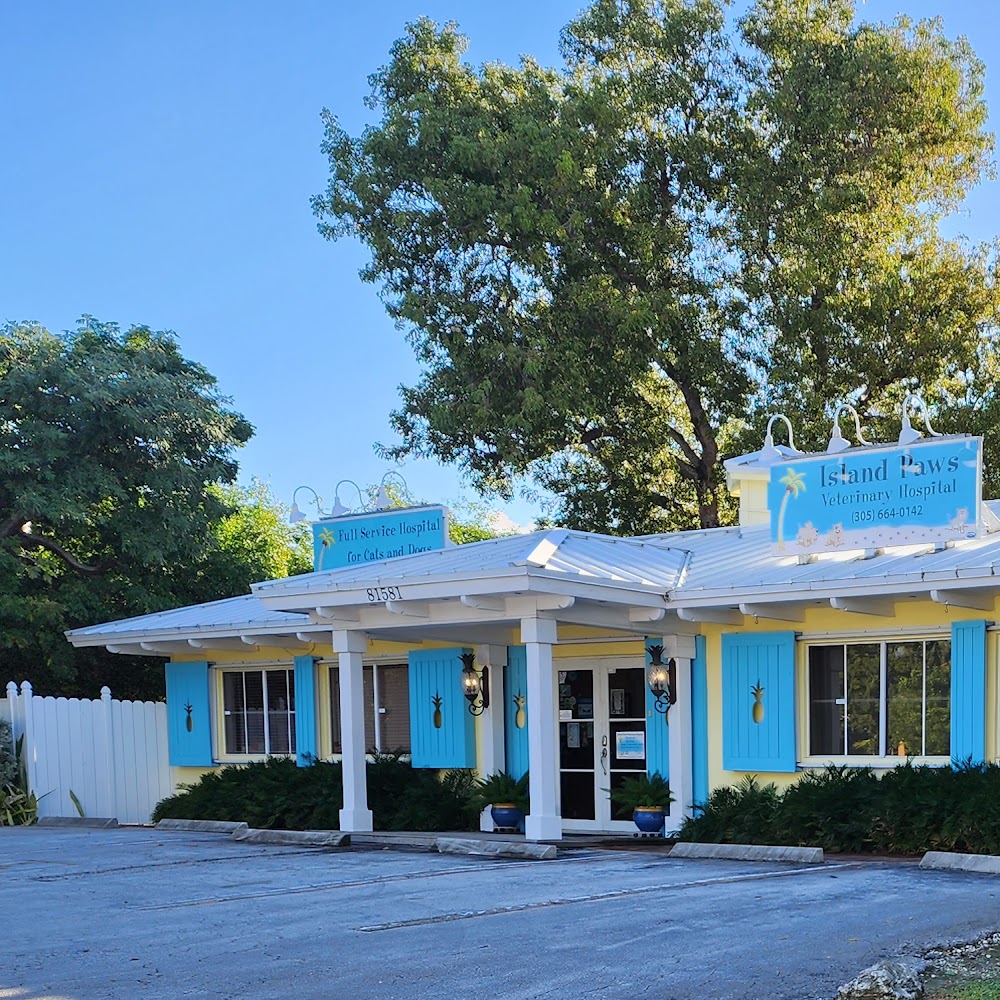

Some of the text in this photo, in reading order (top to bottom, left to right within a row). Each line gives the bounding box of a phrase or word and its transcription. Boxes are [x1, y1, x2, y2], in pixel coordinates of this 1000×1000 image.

[820, 454, 959, 488] Island Paws
[822, 478, 957, 507] Veterinary Hospital
[851, 505, 923, 523] (305) 664-0142
[338, 518, 440, 542] Full Service Hospital
[347, 551, 361, 563] for
[364, 548, 384, 561] Cats
[387, 546, 404, 558] and
[366, 586, 403, 601] 81581
